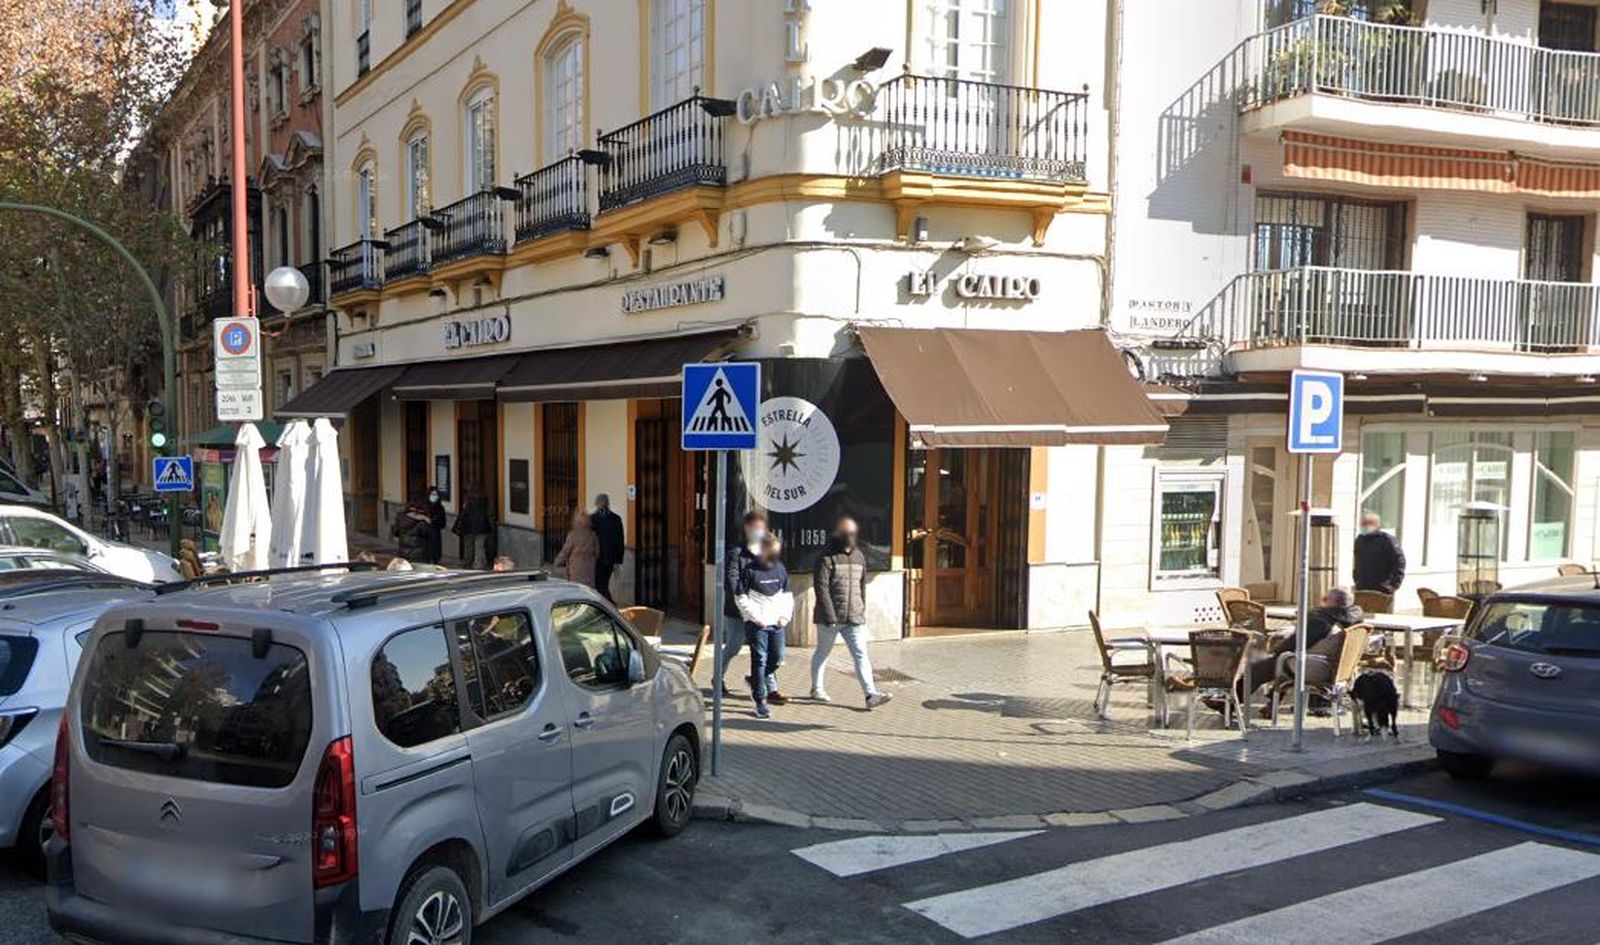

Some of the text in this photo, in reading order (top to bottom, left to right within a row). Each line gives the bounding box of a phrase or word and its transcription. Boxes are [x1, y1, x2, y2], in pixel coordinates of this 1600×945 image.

[736, 75, 877, 124] CAIRO
[620, 276, 725, 313] RESTAURANTE
[911, 271, 1041, 299] EL CAIRO
[461, 315, 511, 344] CAIRO
[761, 409, 812, 429] ESTRELLA
[1300, 380, 1334, 444] P
[765, 484, 808, 500] DEL SUR
